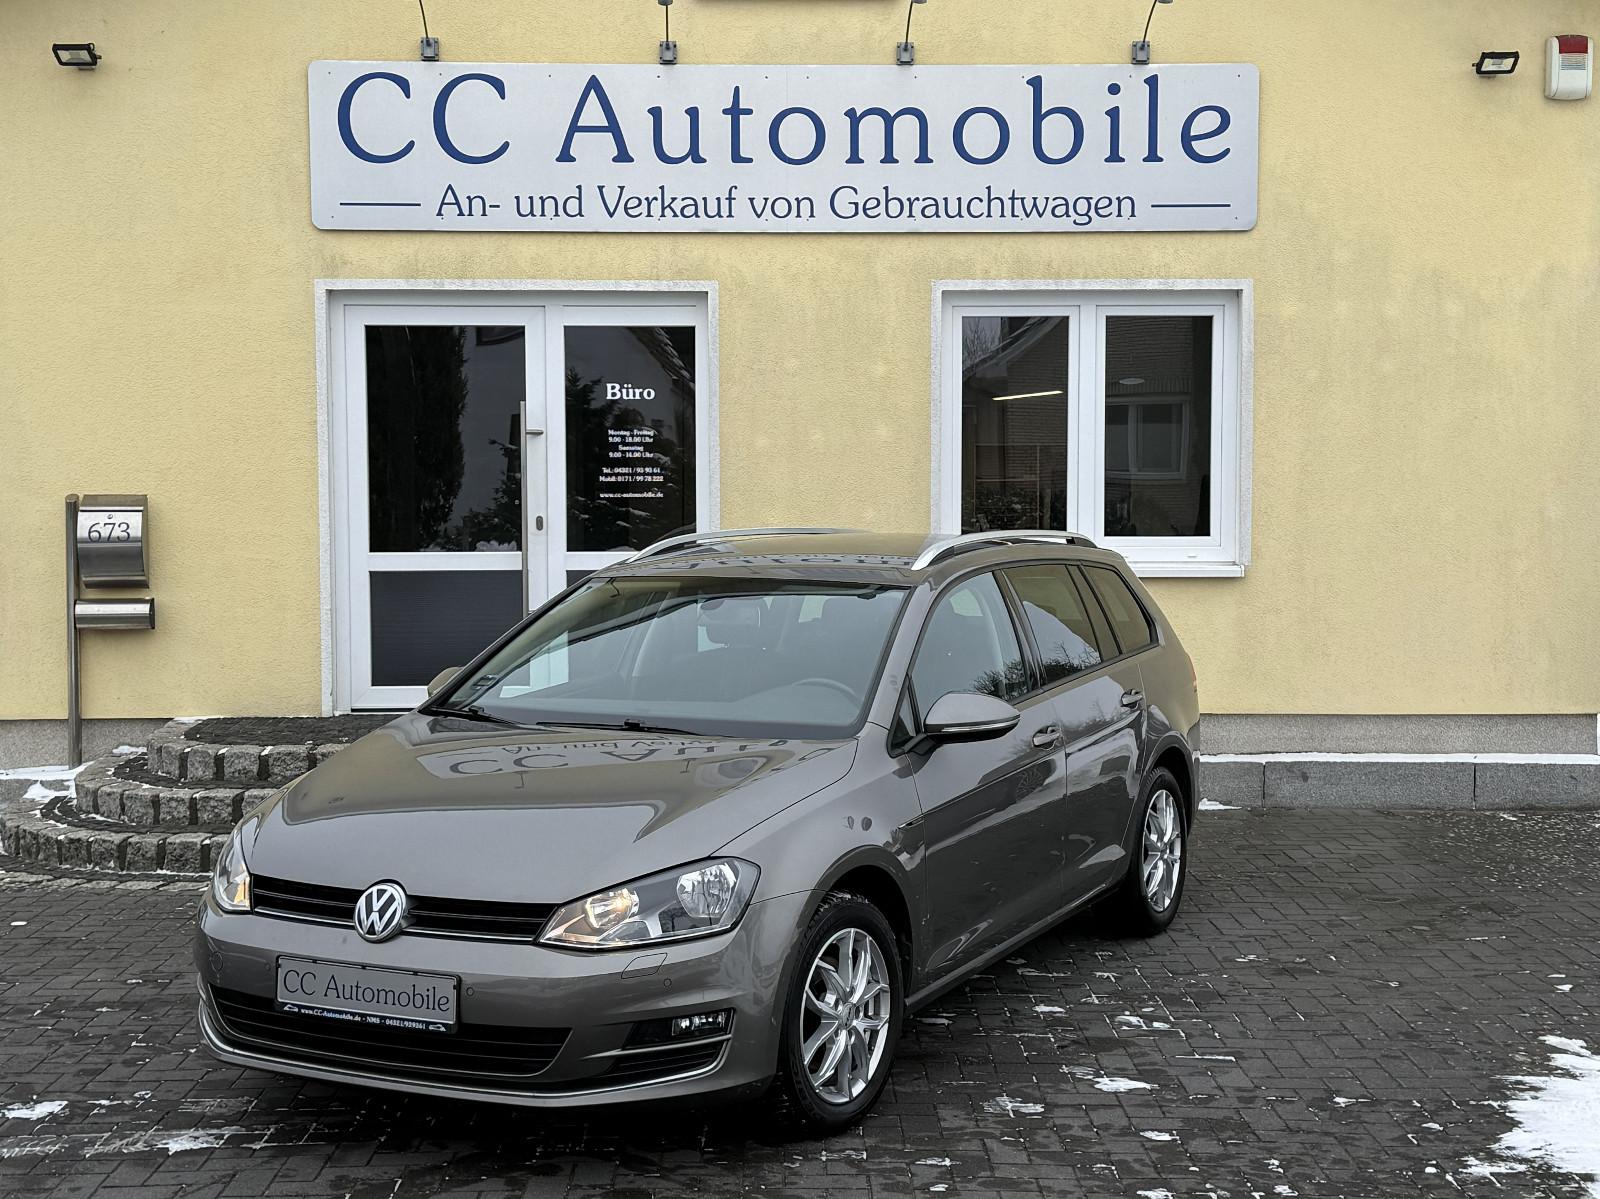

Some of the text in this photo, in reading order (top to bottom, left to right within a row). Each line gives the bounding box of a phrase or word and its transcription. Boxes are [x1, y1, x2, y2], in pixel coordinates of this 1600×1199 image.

[337, 72, 1232, 165] CC Automobile
[435, 184, 1137, 226] An- und Verkauf von Gebrauchtwagen
[605, 382, 656, 401] Büro
[88, 522, 131, 543] 673
[283, 969, 450, 1012] CC Automobile
